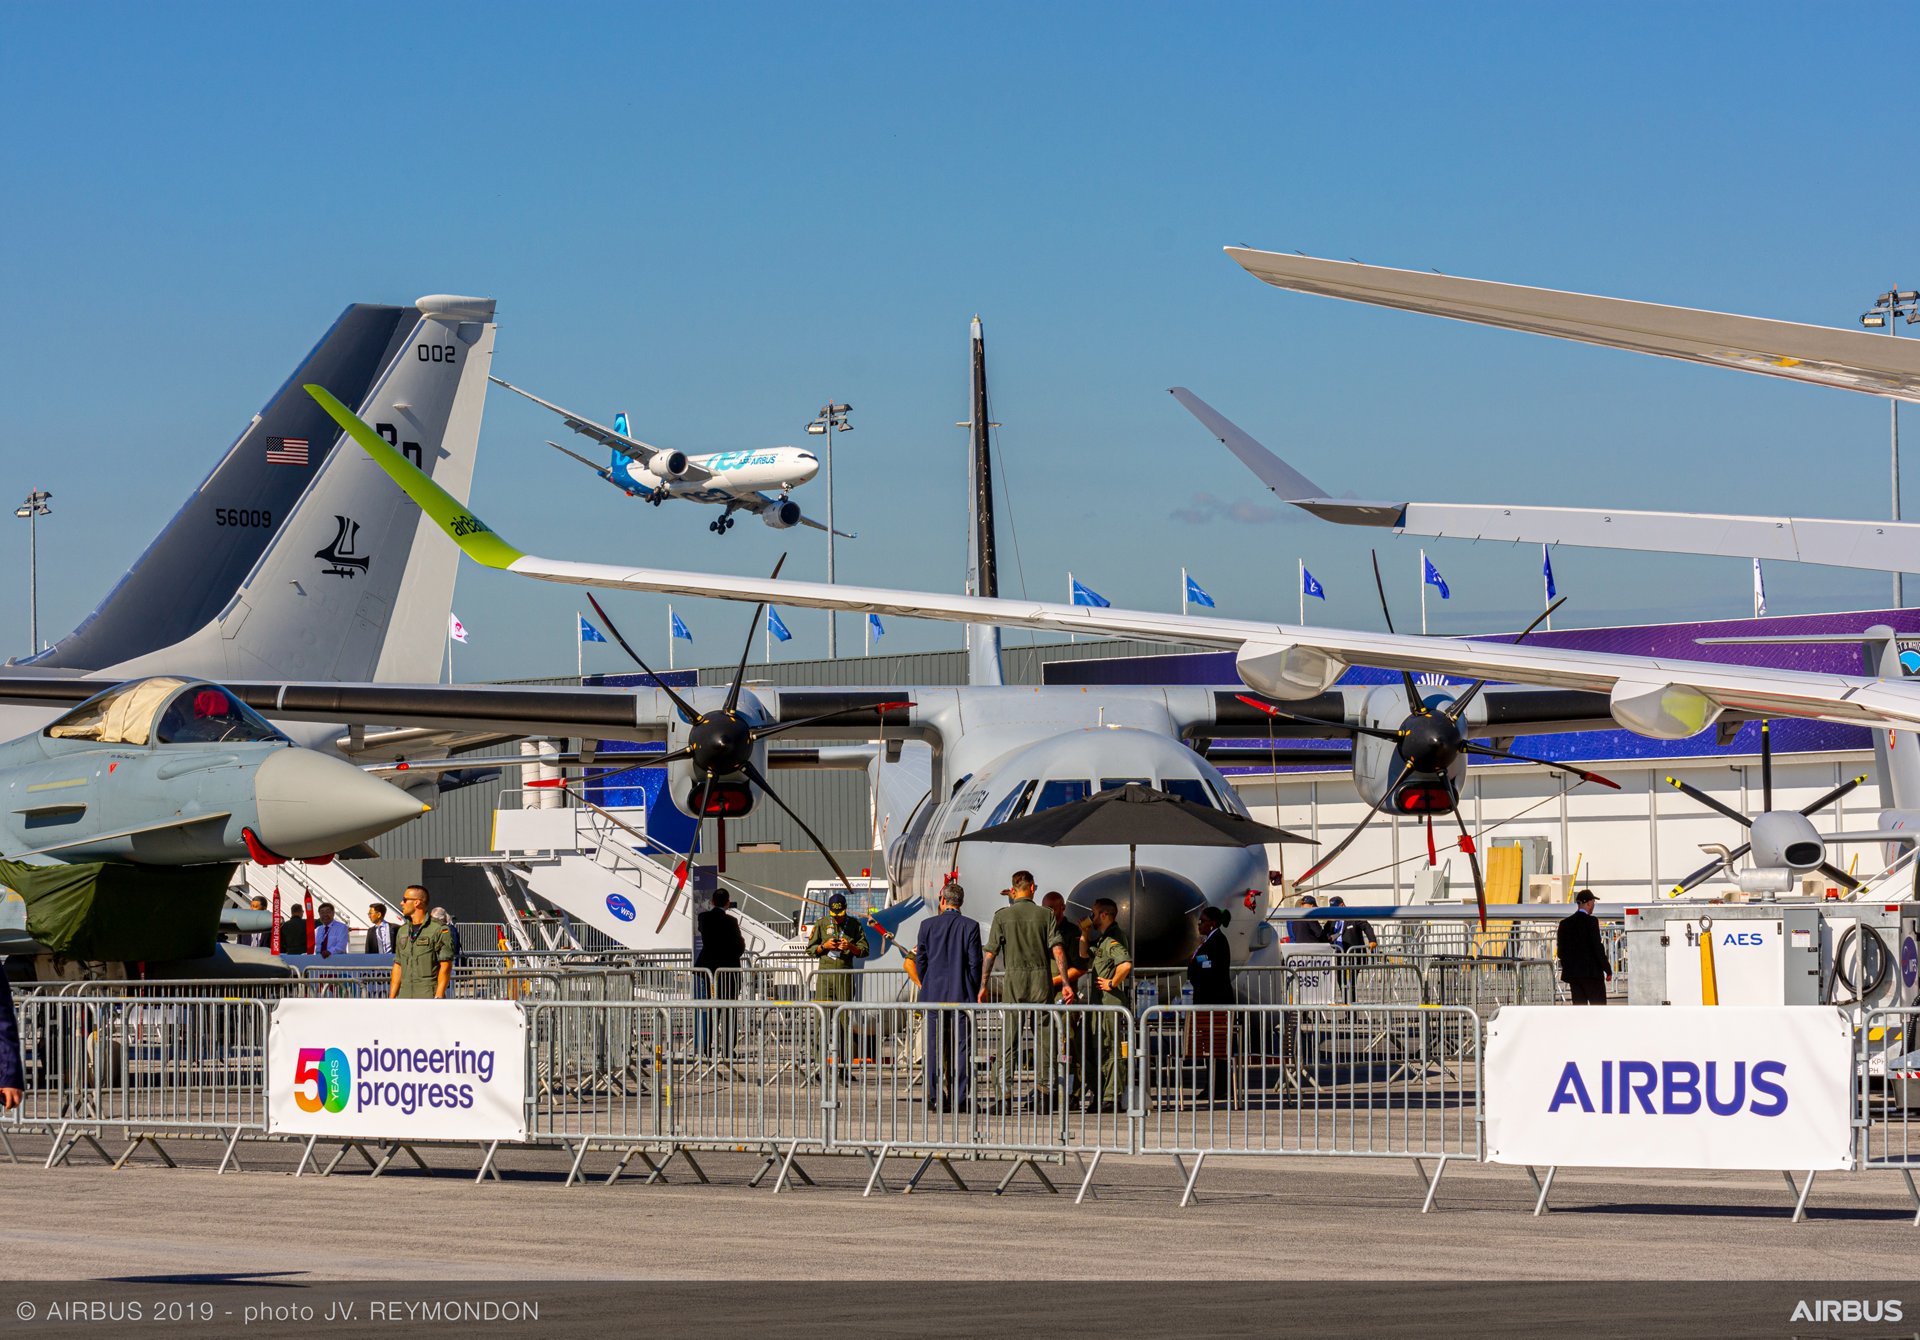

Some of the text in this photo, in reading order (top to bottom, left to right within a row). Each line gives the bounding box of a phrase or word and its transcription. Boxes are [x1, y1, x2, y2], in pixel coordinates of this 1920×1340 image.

[418, 344, 456, 363] 002
[750, 455, 776, 466] AIRBUS
[215, 508, 273, 528] 56009
[620, 906, 634, 920] WFS
[1723, 933, 1763, 946] AES
[294, 1039, 495, 1114] 50 pioneering
[331, 1059, 474, 1116] YEARS progress
[1547, 1060, 1789, 1118] AIRBUS
